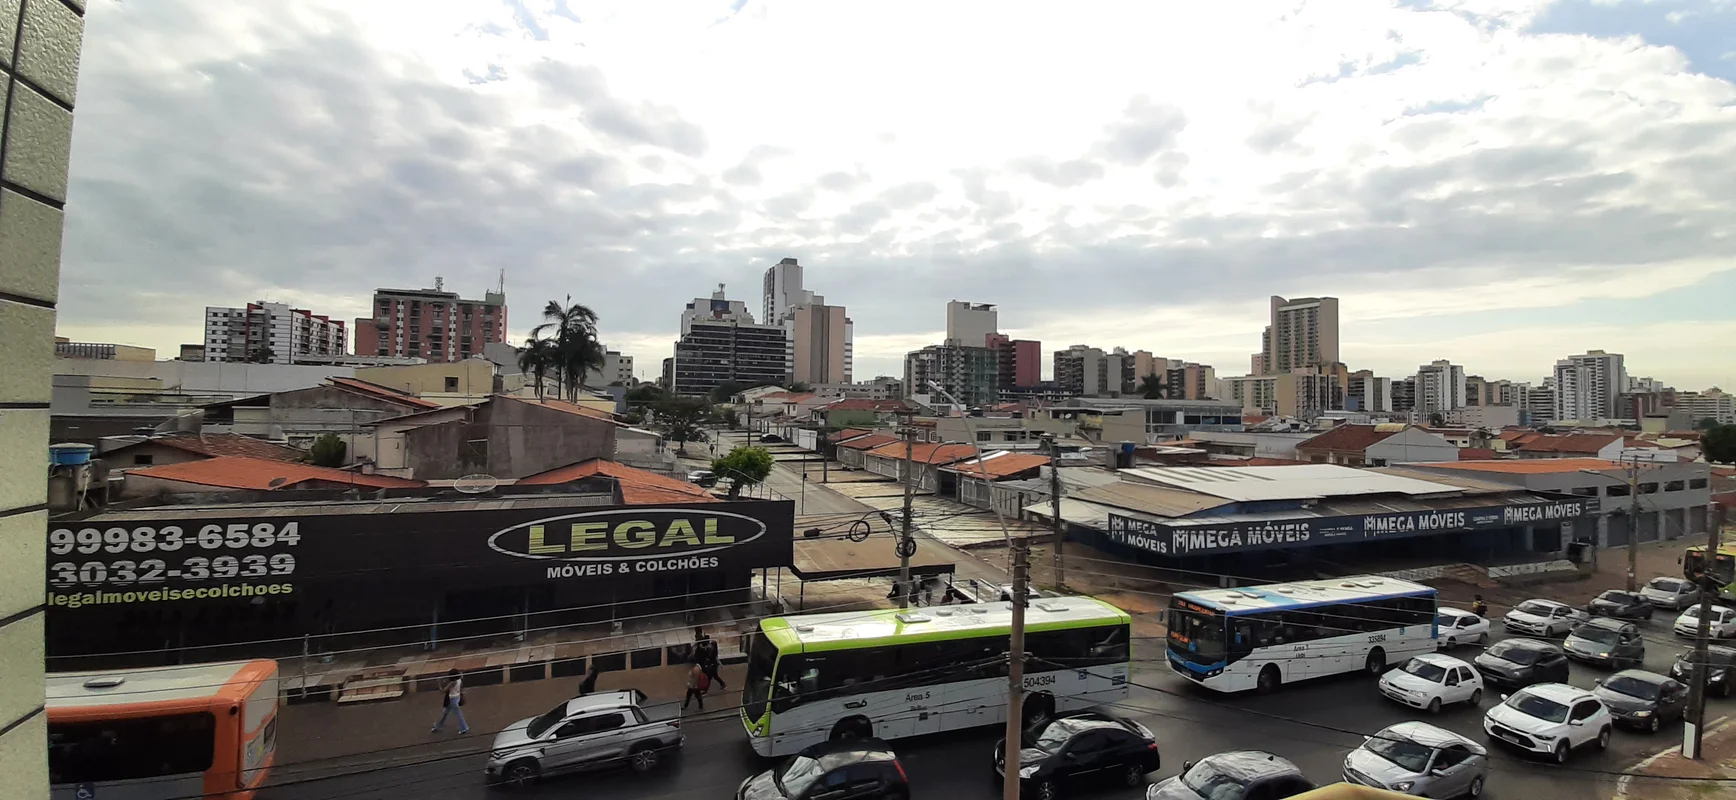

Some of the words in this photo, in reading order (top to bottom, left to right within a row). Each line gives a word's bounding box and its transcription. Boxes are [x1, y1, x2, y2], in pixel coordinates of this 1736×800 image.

[1376, 515, 1415, 534] MEGA
[1418, 509, 1465, 530] MÓVEIS
[1513, 506, 1543, 522] MEGA
[1545, 501, 1581, 519] MÓVEIS
[50, 522, 301, 555] 99983-6584
[528, 517, 735, 555] LEGAL
[1127, 520, 1157, 537] MEGA
[1189, 527, 1242, 550] MEGA
[1247, 521, 1310, 545] MÓVEIS
[1127, 534, 1167, 554] MÓVEIS
[49, 553, 296, 588] 3032-3939
[547, 563, 613, 579] MÓVEIS
[618, 562, 630, 573] &
[635, 556, 719, 572] COLCHÕES
[47, 583, 293, 608] legalmoveisecolchoes
[1023, 675, 1056, 688] 504394
[925, 691, 931, 699] 5
